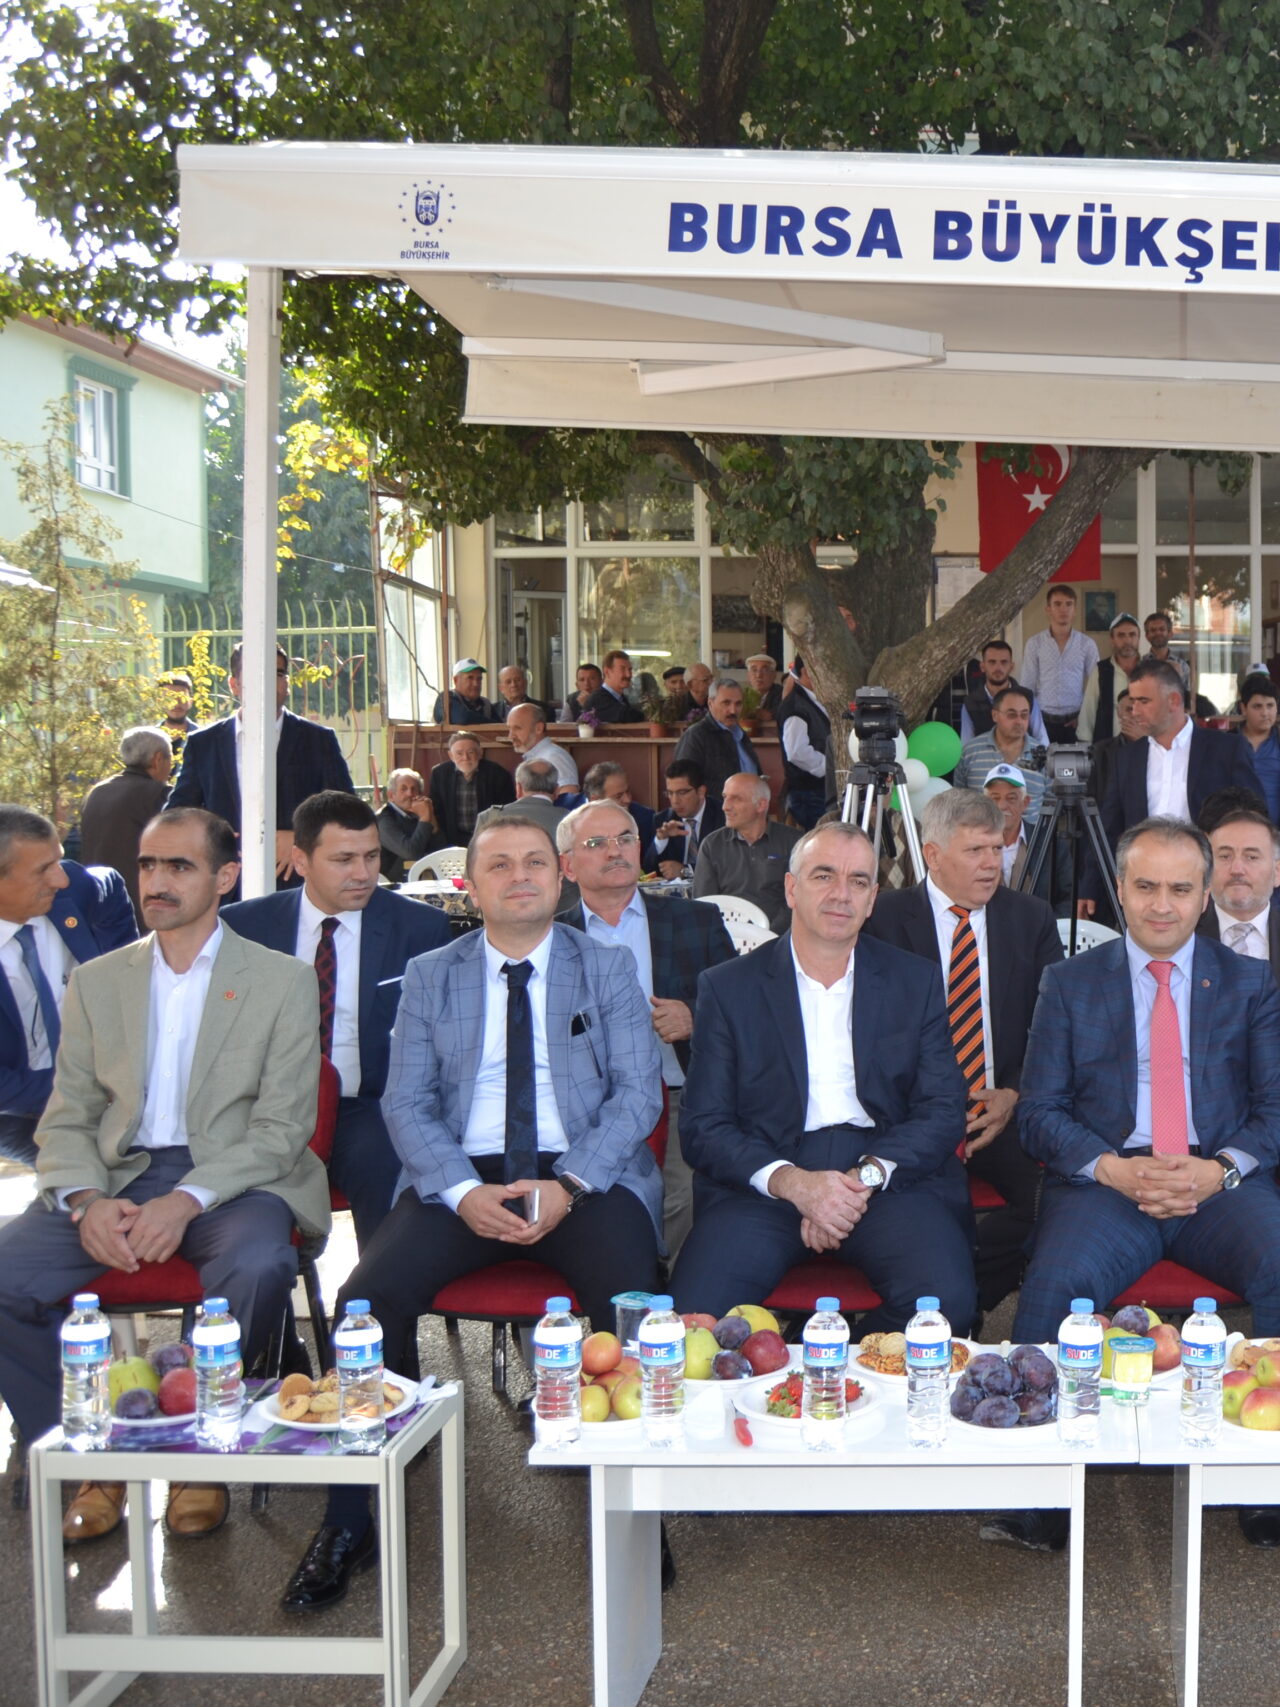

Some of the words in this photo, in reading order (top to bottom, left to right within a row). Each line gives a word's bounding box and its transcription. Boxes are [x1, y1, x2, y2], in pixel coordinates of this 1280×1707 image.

[668, 202, 903, 259] BURSA
[413, 241, 440, 249] BURSA
[400, 249, 450, 262] BÜYÜKŞEHİR
[808, 1347, 838, 1359] SUDE
[910, 1347, 938, 1359] SUDE
[1066, 1348, 1095, 1360] SUDE
